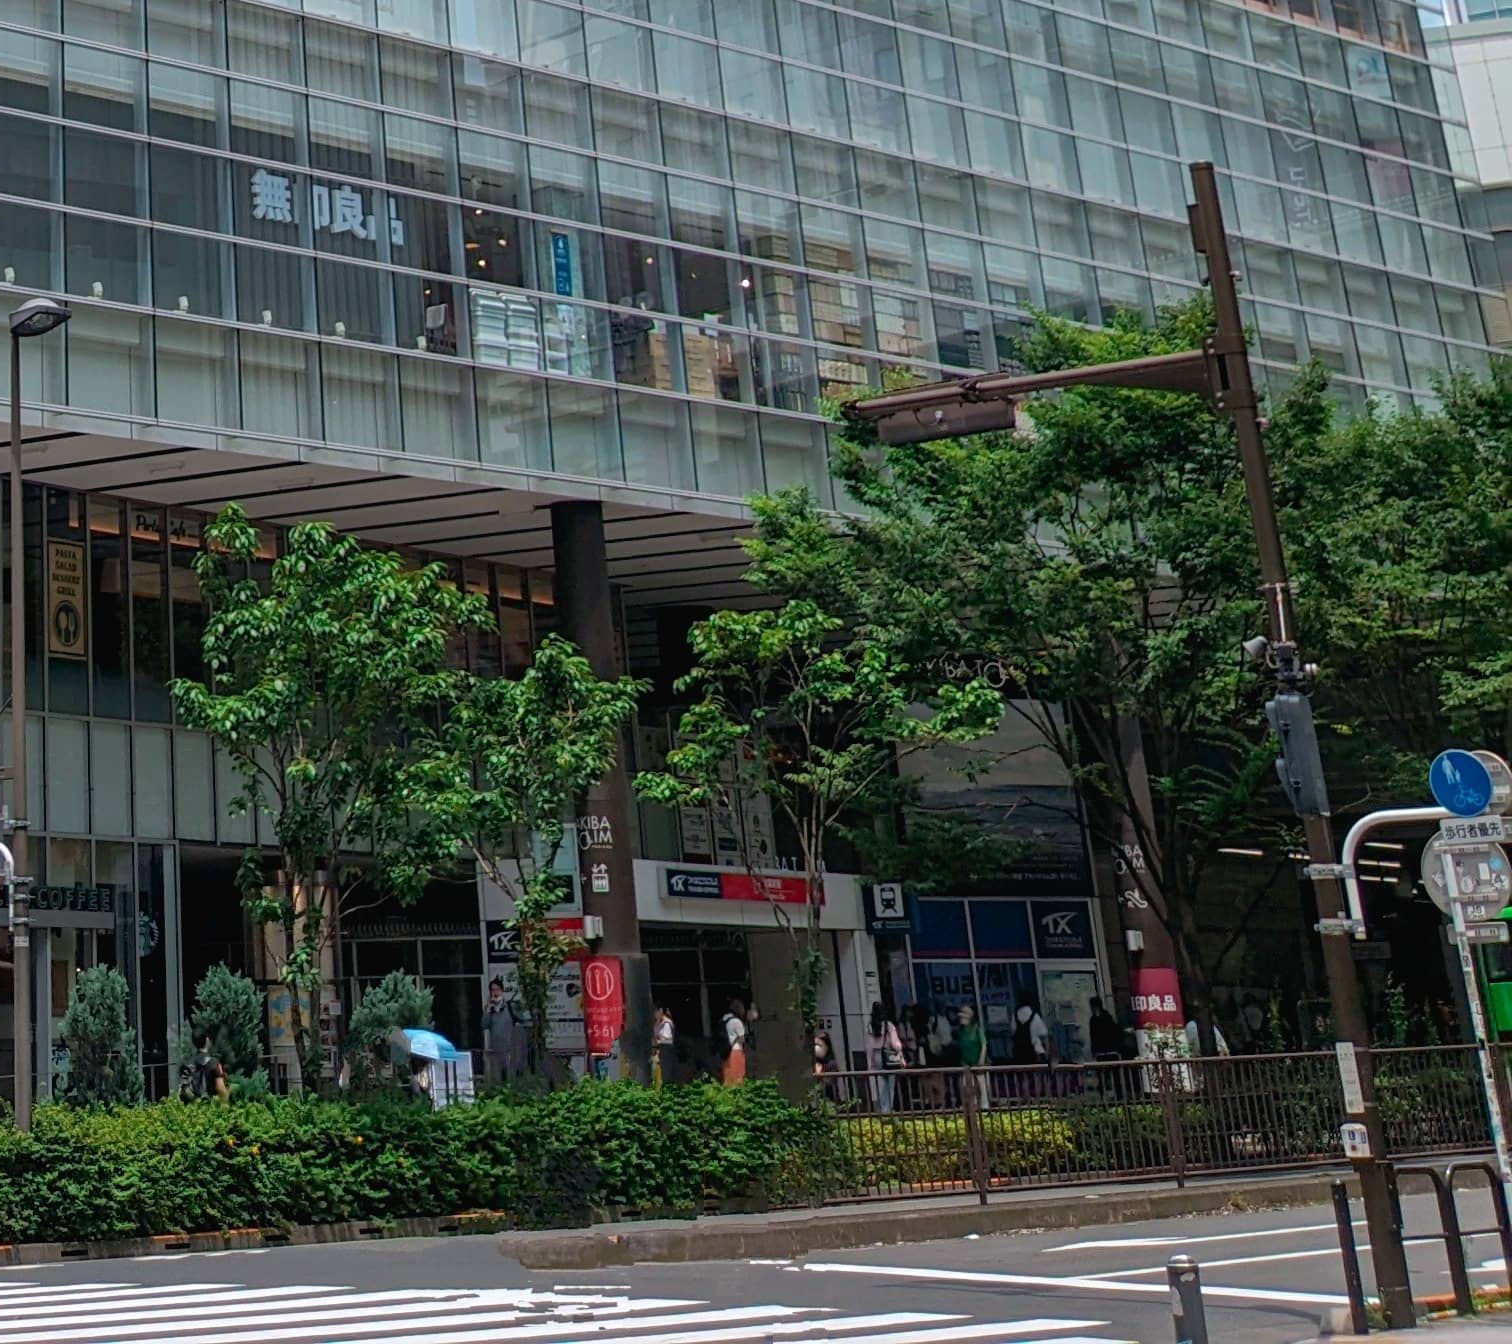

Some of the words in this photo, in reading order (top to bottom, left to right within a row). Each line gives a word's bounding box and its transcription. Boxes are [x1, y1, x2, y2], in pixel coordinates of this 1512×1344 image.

[1445, 822, 1502, 840] 歩行者優先
[38, 888, 111, 911] COFFEE
[1042, 912, 1078, 934] TX
[1131, 994, 1176, 1012] 印良品
